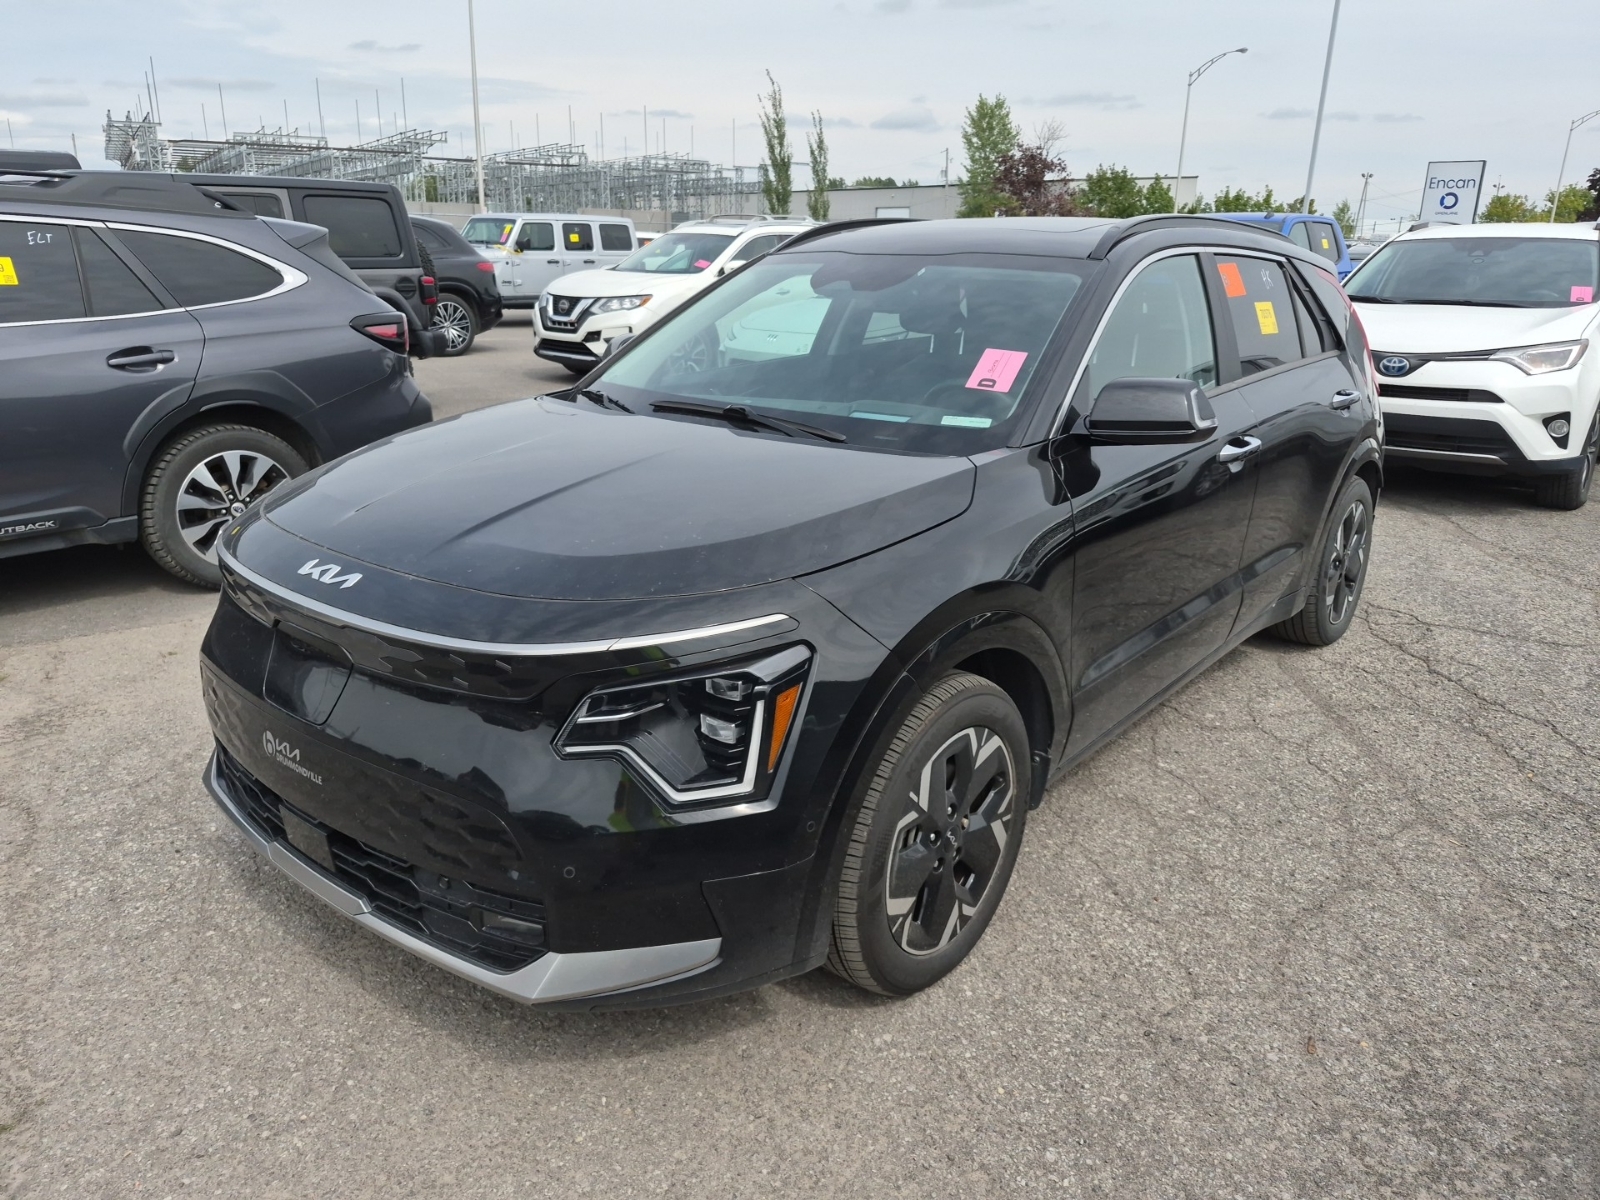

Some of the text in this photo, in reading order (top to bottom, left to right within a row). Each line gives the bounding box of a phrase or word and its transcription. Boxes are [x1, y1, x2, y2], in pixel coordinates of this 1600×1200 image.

[1429, 177, 1476, 189] Encan
[27, 230, 53, 245] ELT
[977, 378, 997, 389] D
[297, 558, 363, 589] KIA
[275, 738, 300, 762] KIA
[276, 752, 323, 786] DRUMMONDVILLE
